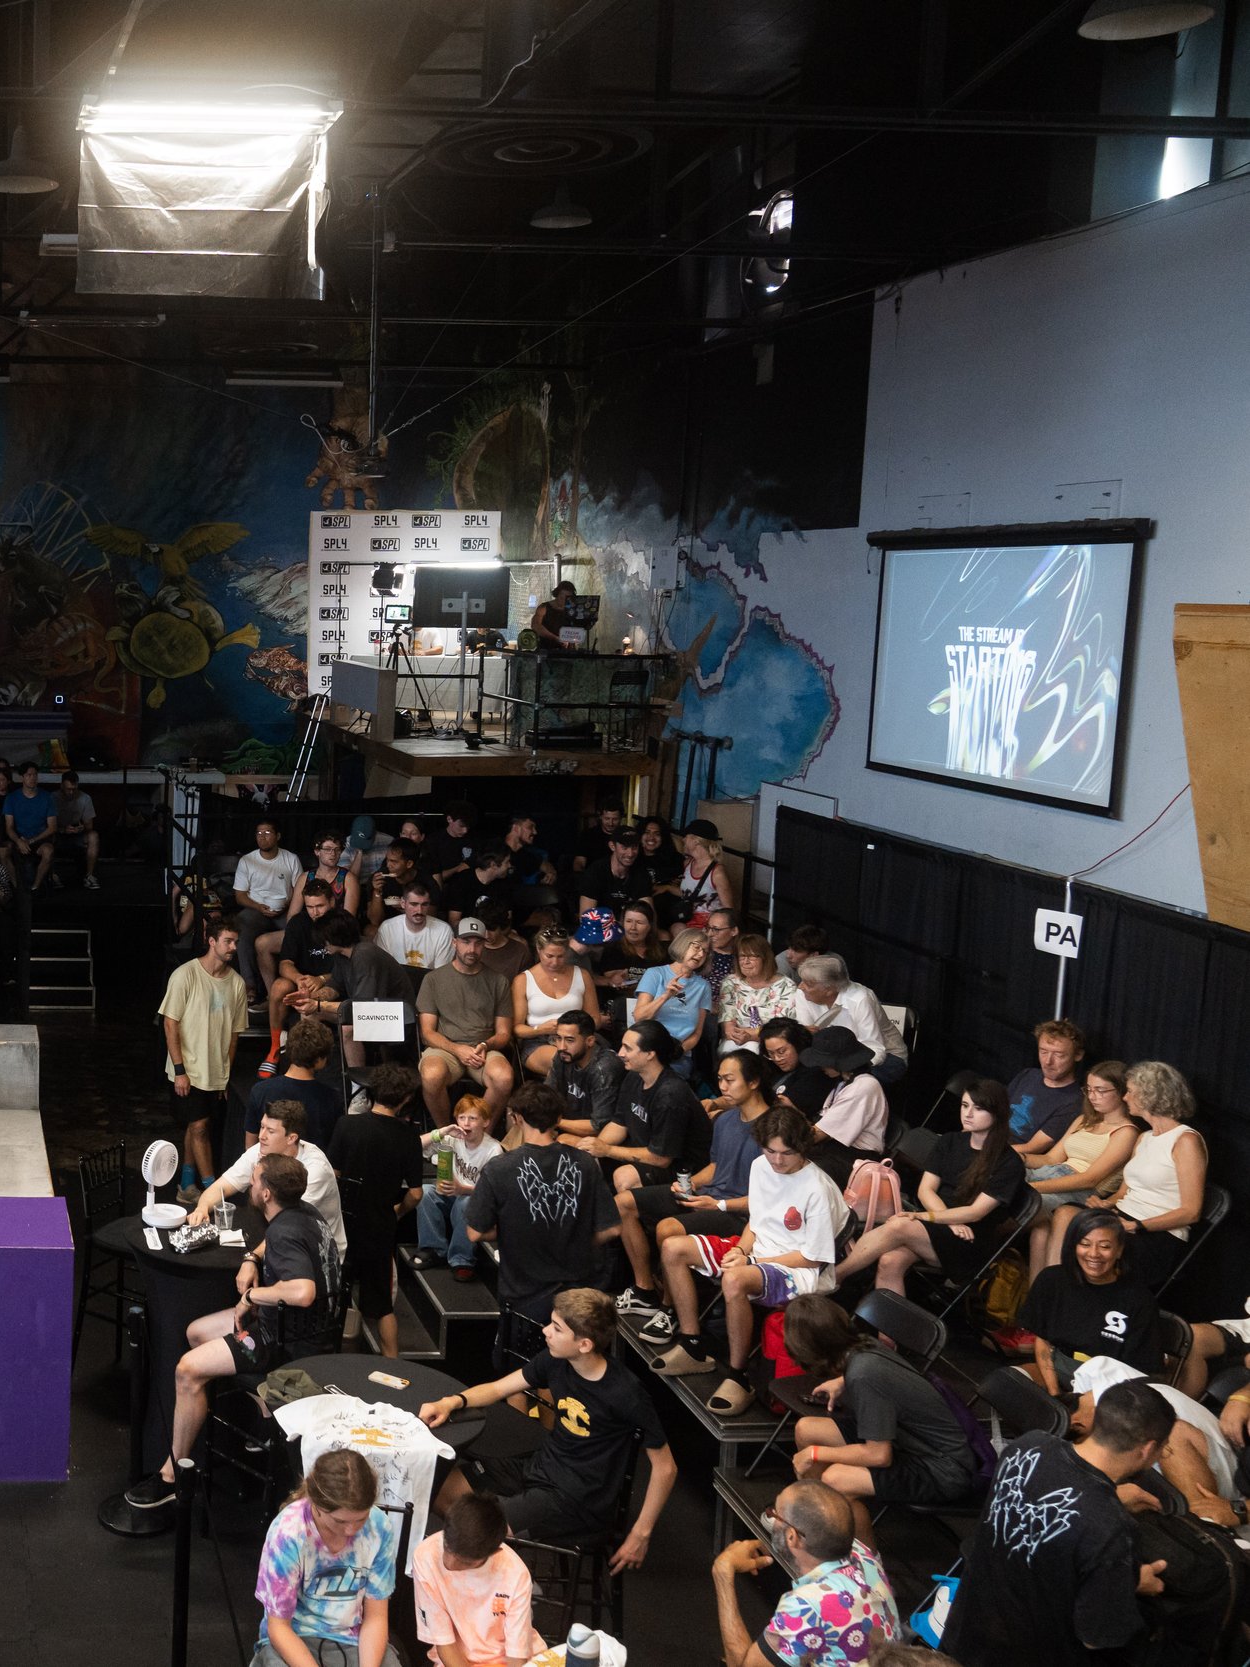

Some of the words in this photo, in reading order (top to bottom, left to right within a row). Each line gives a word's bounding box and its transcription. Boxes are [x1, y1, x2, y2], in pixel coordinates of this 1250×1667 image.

[332, 516, 349, 527] SPL
[374, 515, 398, 526] SPL4
[423, 516, 439, 527] SPL
[464, 515, 488, 526] SPL4
[324, 538, 347, 549] SPL4
[381, 539, 398, 550] SPL
[414, 537, 438, 548] SPL4
[471, 539, 488, 550] SPL
[958, 626, 975, 642] THE
[976, 627, 1013, 644] STREAM
[1044, 921, 1078, 949] PA
